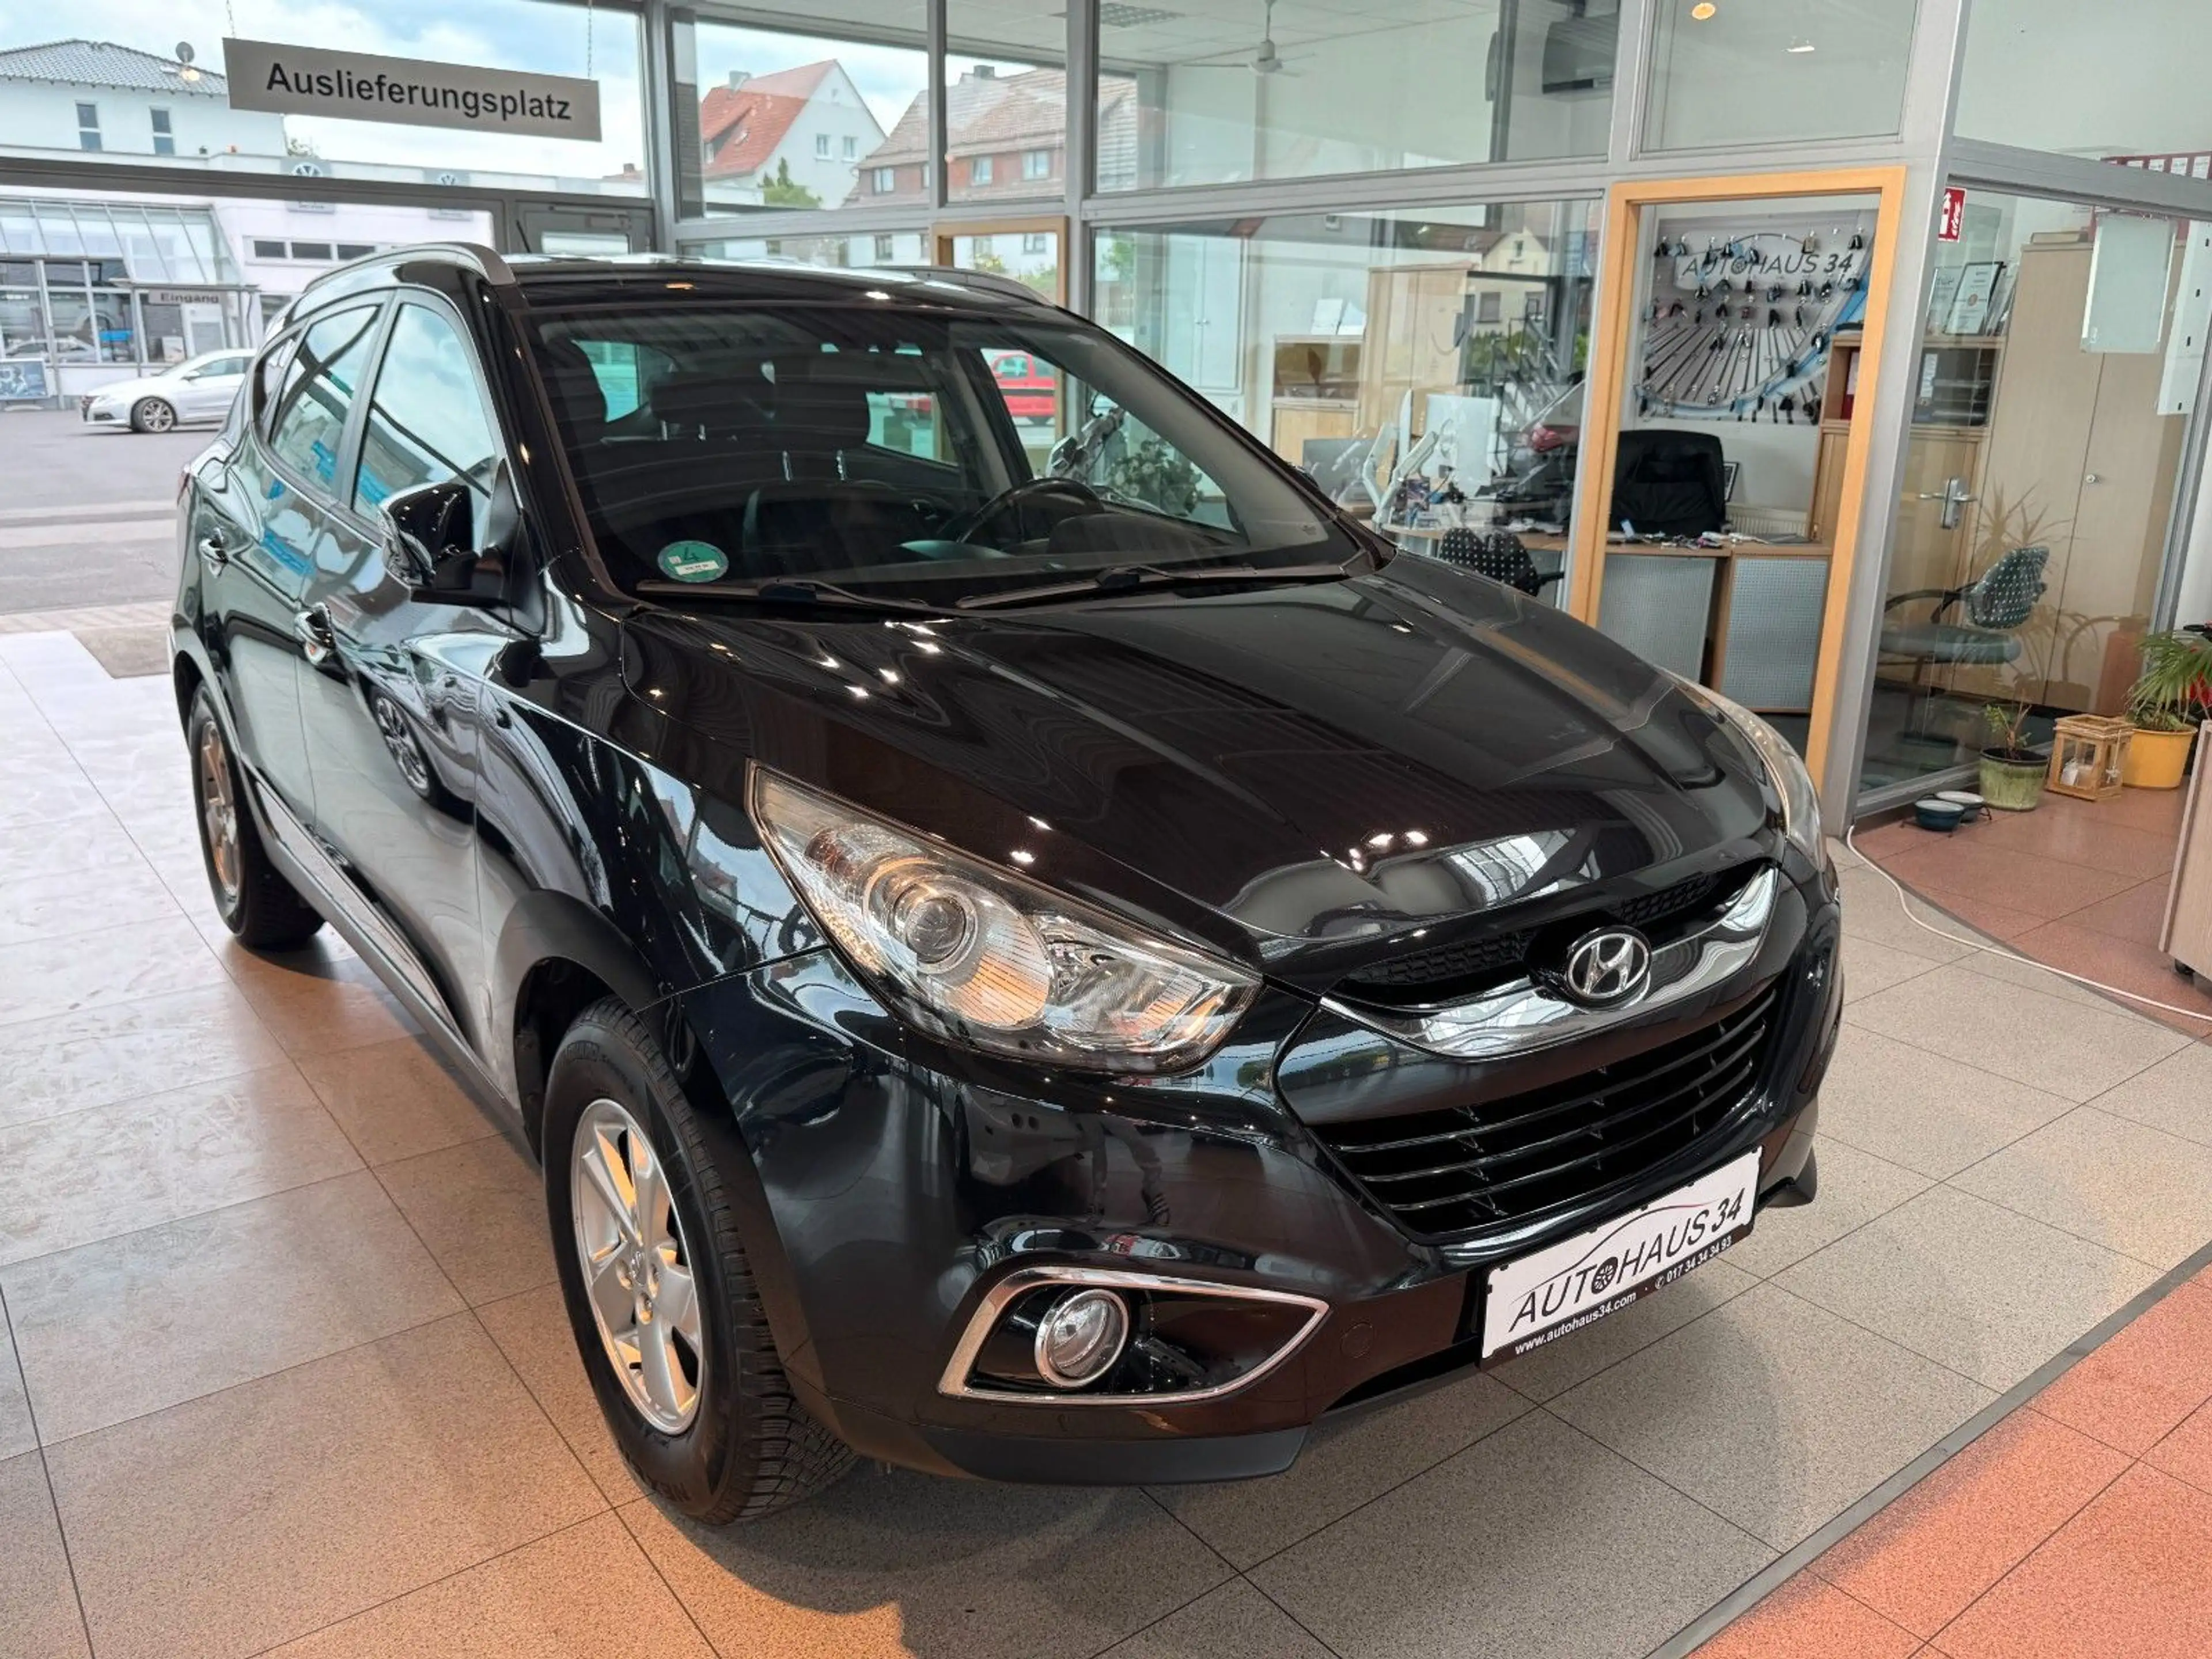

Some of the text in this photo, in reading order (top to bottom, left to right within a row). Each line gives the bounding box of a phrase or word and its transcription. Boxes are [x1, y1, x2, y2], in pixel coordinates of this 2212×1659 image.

[266, 63, 573, 122] Auslieferungsplatz
[1823, 253, 1853, 273] 34
[161, 293, 219, 304] Eingang
[1514, 1291, 1637, 1355] www.autohaus34.com
